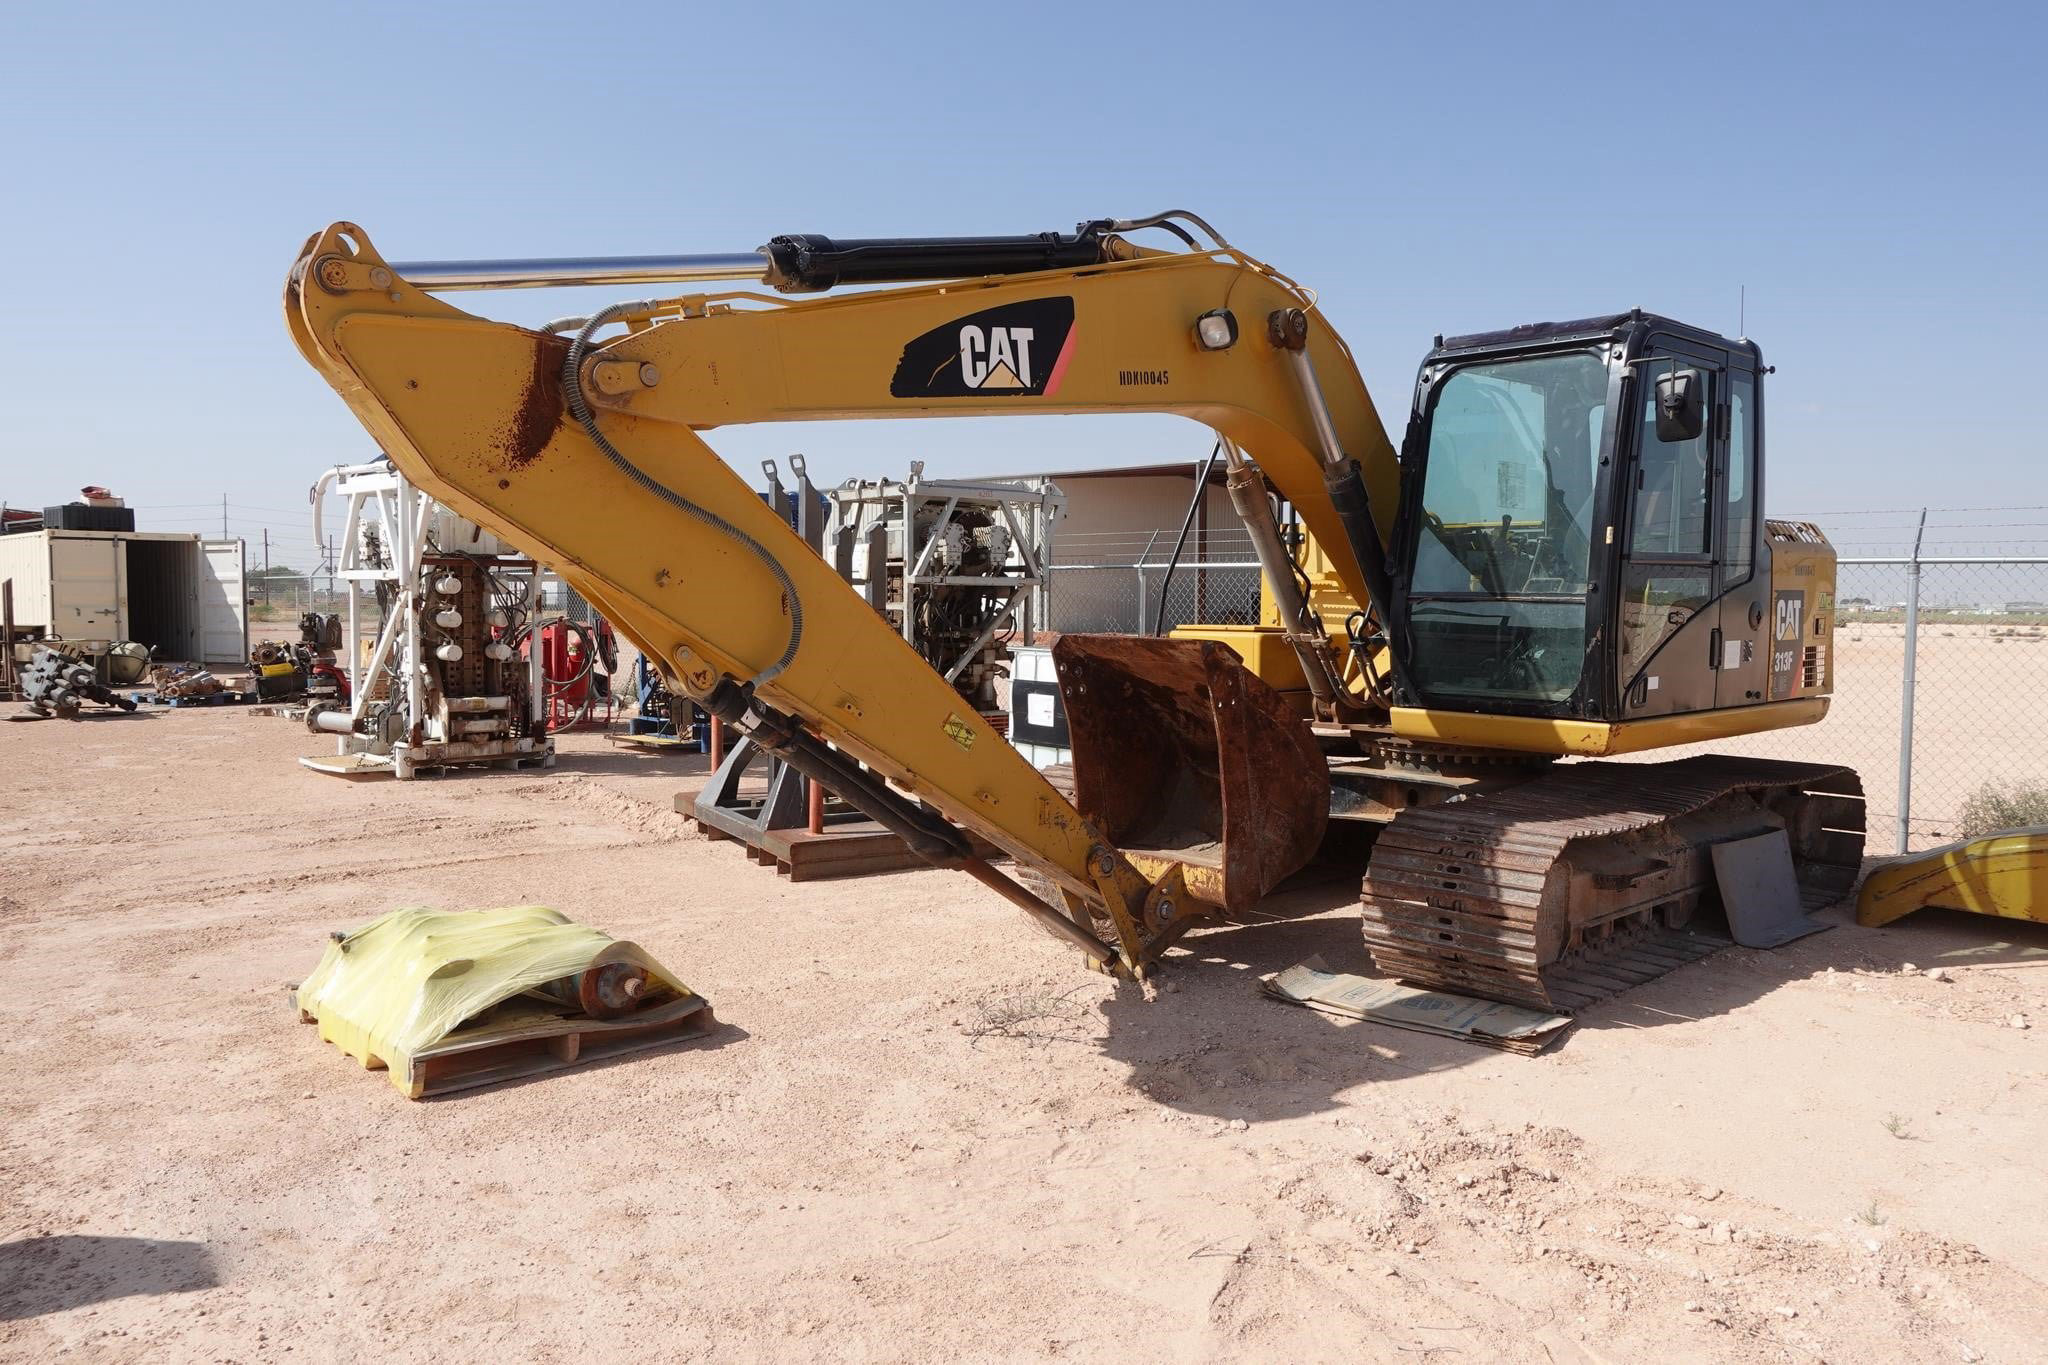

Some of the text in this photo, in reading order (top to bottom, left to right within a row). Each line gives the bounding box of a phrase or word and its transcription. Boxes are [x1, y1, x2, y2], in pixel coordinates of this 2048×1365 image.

[960, 325, 1034, 388] CAT
[1119, 370, 1169, 386] HDK10045
[1776, 599, 1801, 641] CAT
[1774, 651, 1793, 672] 313F
